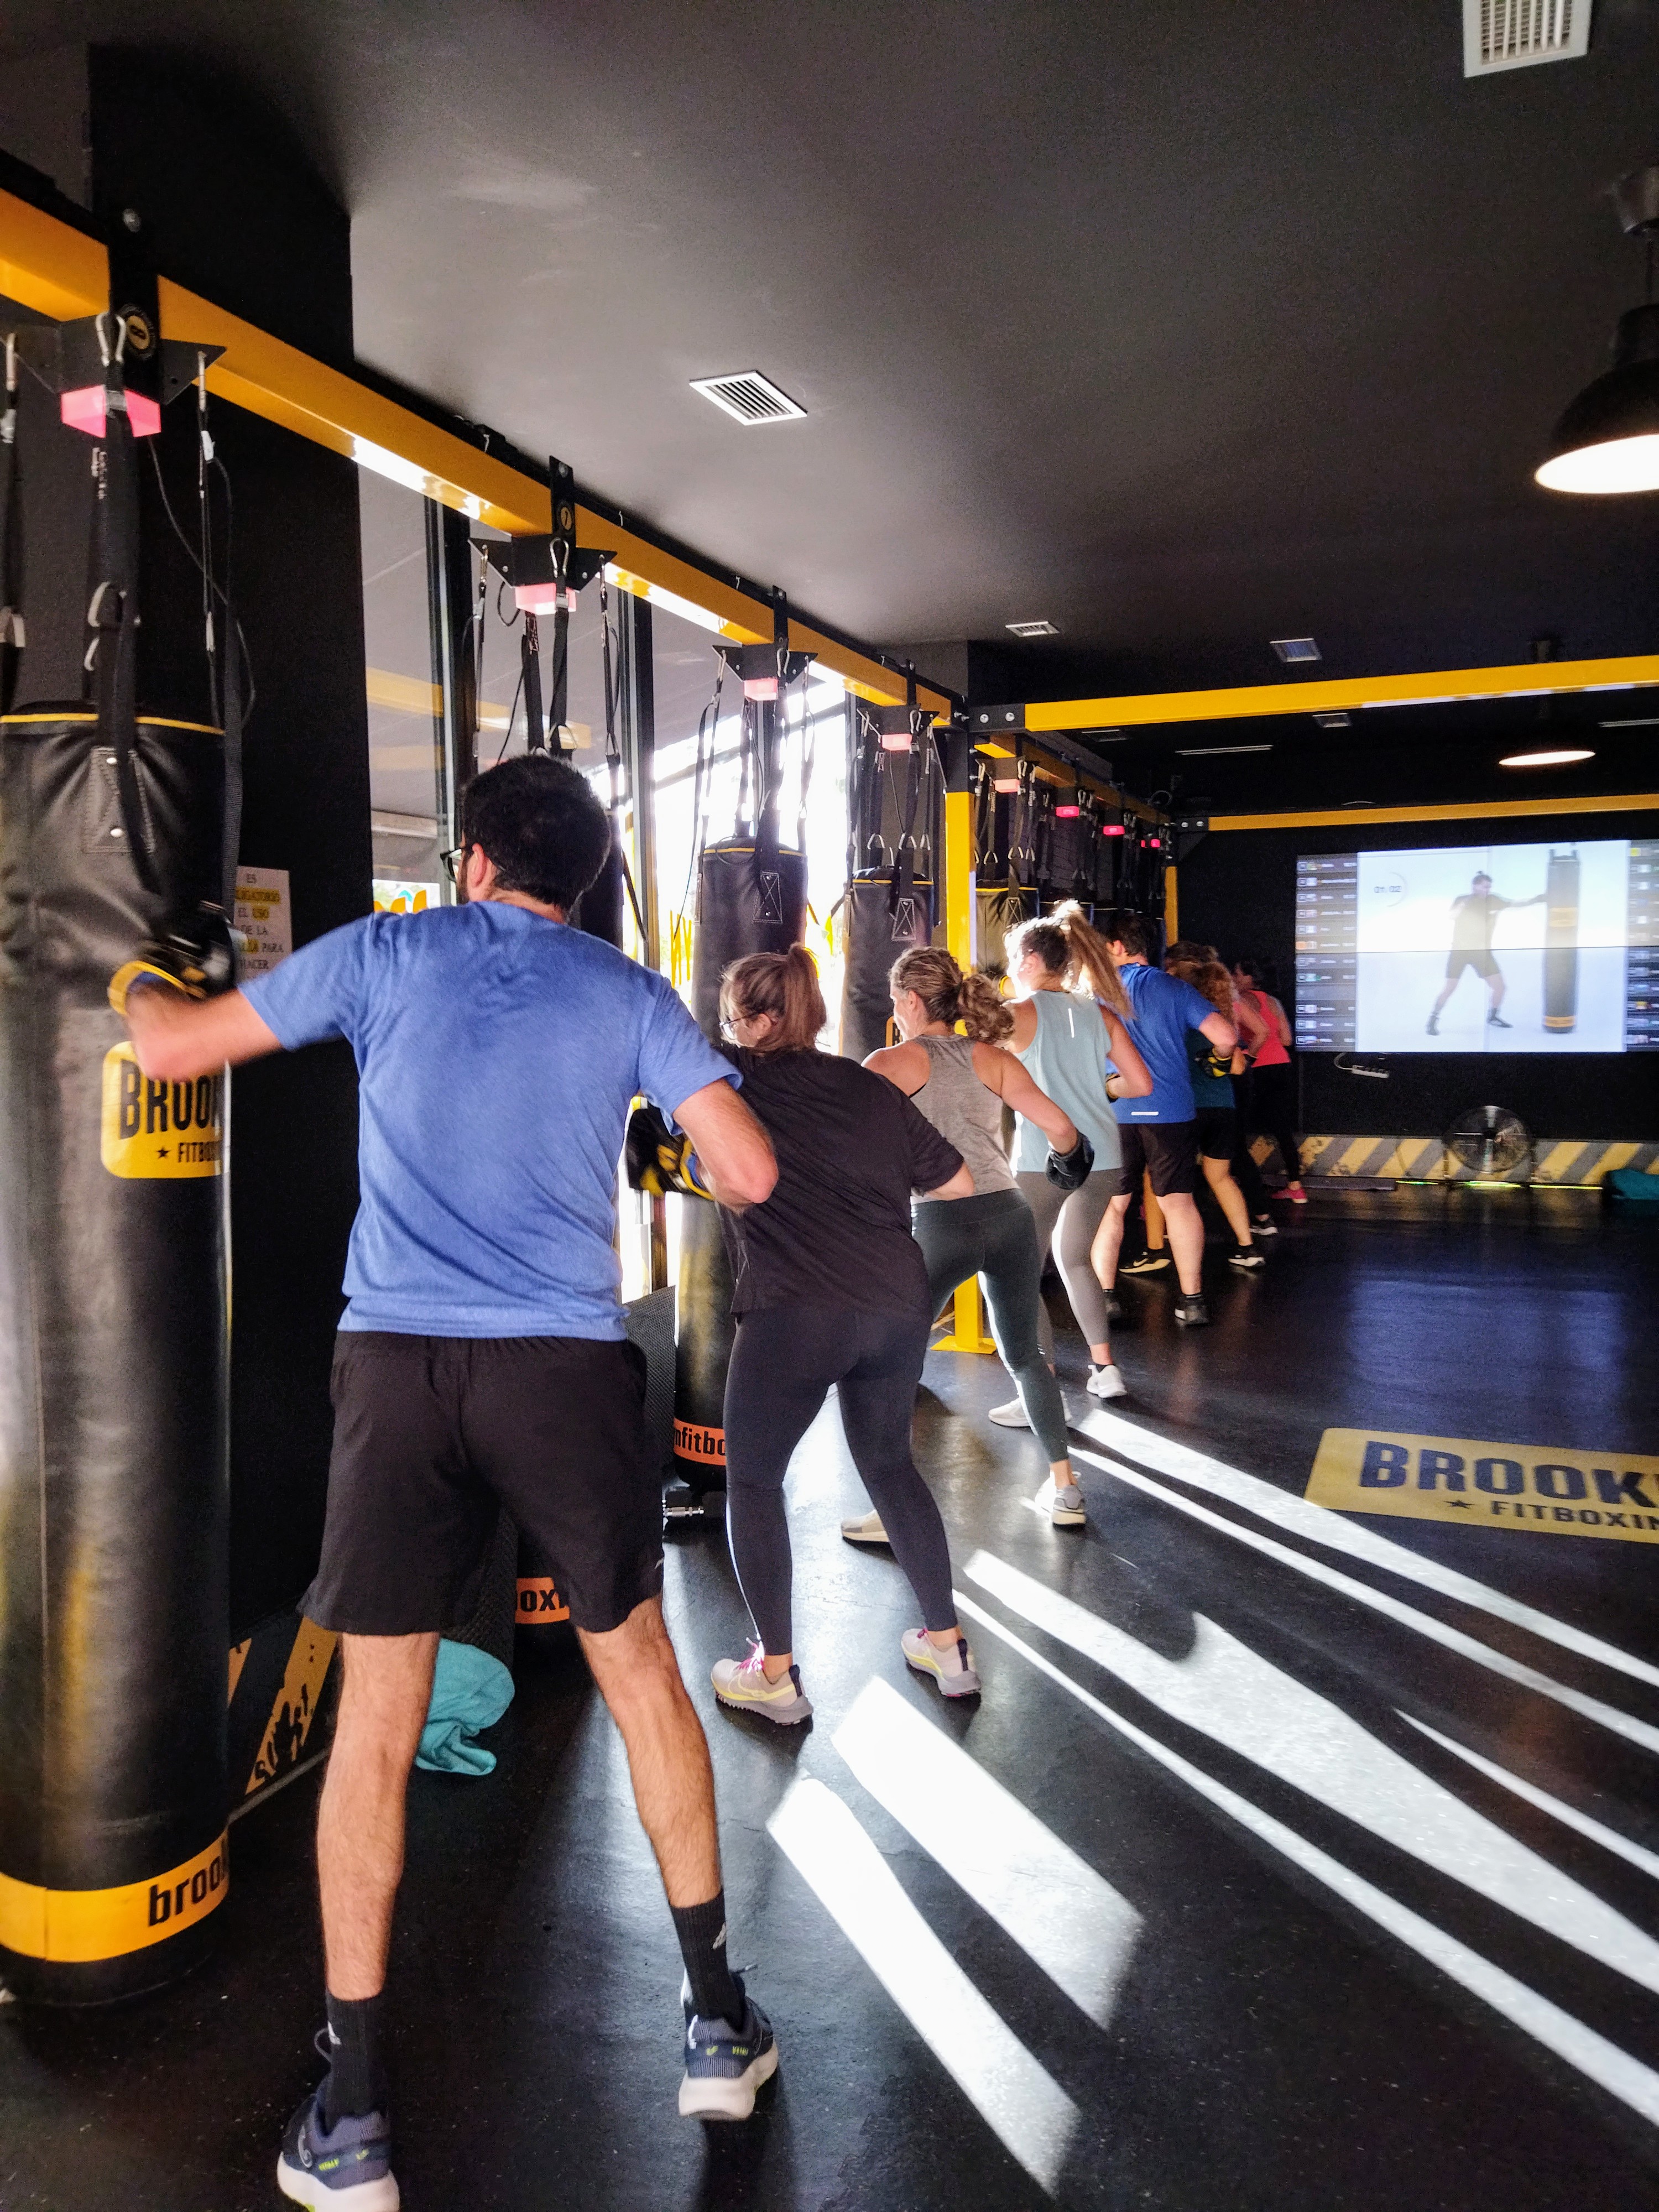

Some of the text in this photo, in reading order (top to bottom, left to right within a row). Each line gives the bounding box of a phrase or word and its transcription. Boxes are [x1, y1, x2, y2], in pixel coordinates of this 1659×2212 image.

[119, 1058, 222, 1140] BROO
[674, 1427, 726, 1456] nfitbo
[1359, 1440, 1659, 1509] BROOK
